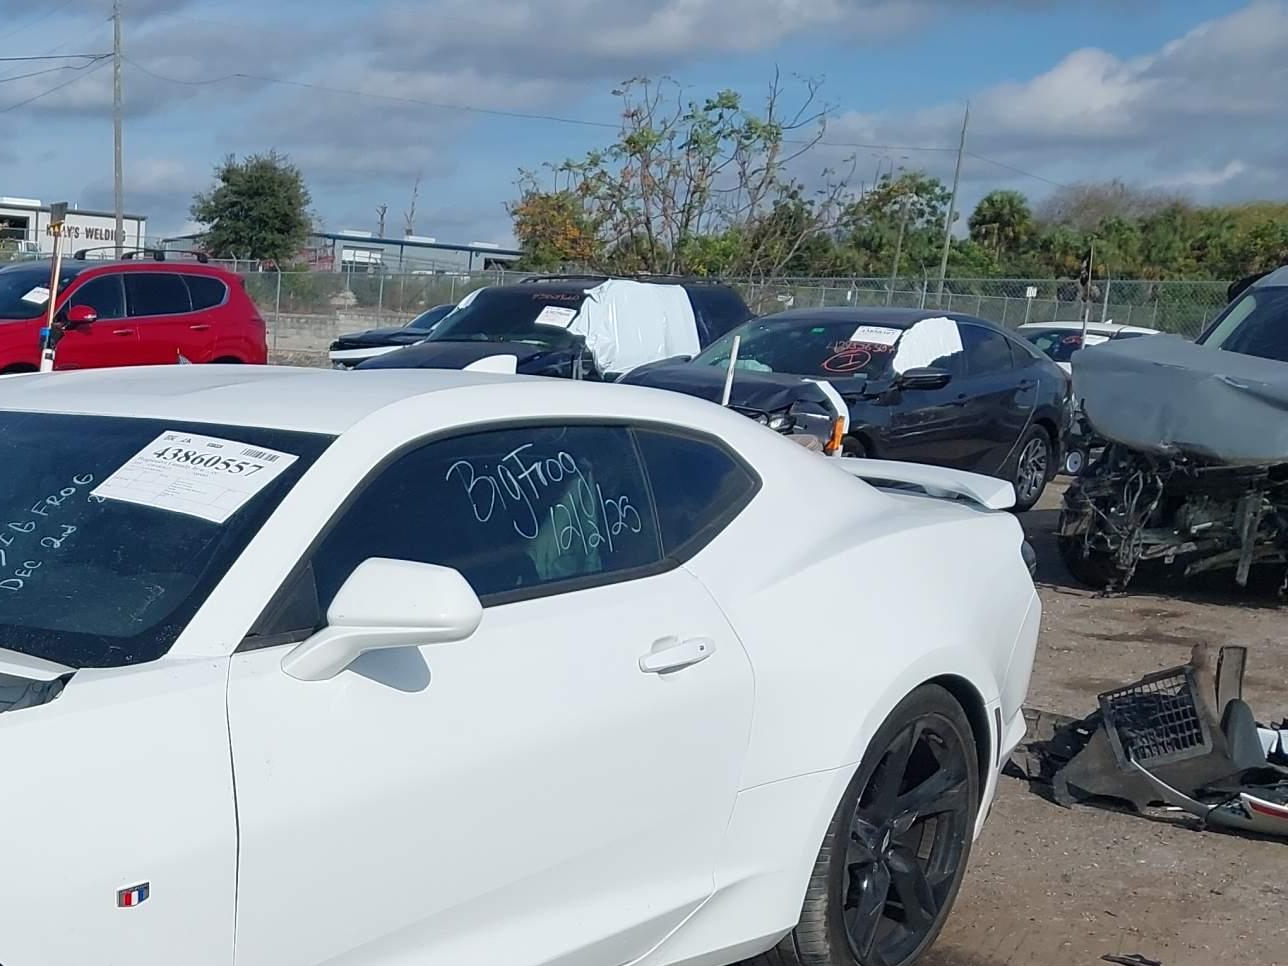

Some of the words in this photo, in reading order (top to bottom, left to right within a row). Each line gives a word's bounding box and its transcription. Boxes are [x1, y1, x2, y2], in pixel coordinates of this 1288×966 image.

[85, 227, 126, 242] WELDIG
[153, 446, 265, 477] 43860557
[31, 472, 94, 516] FROG
